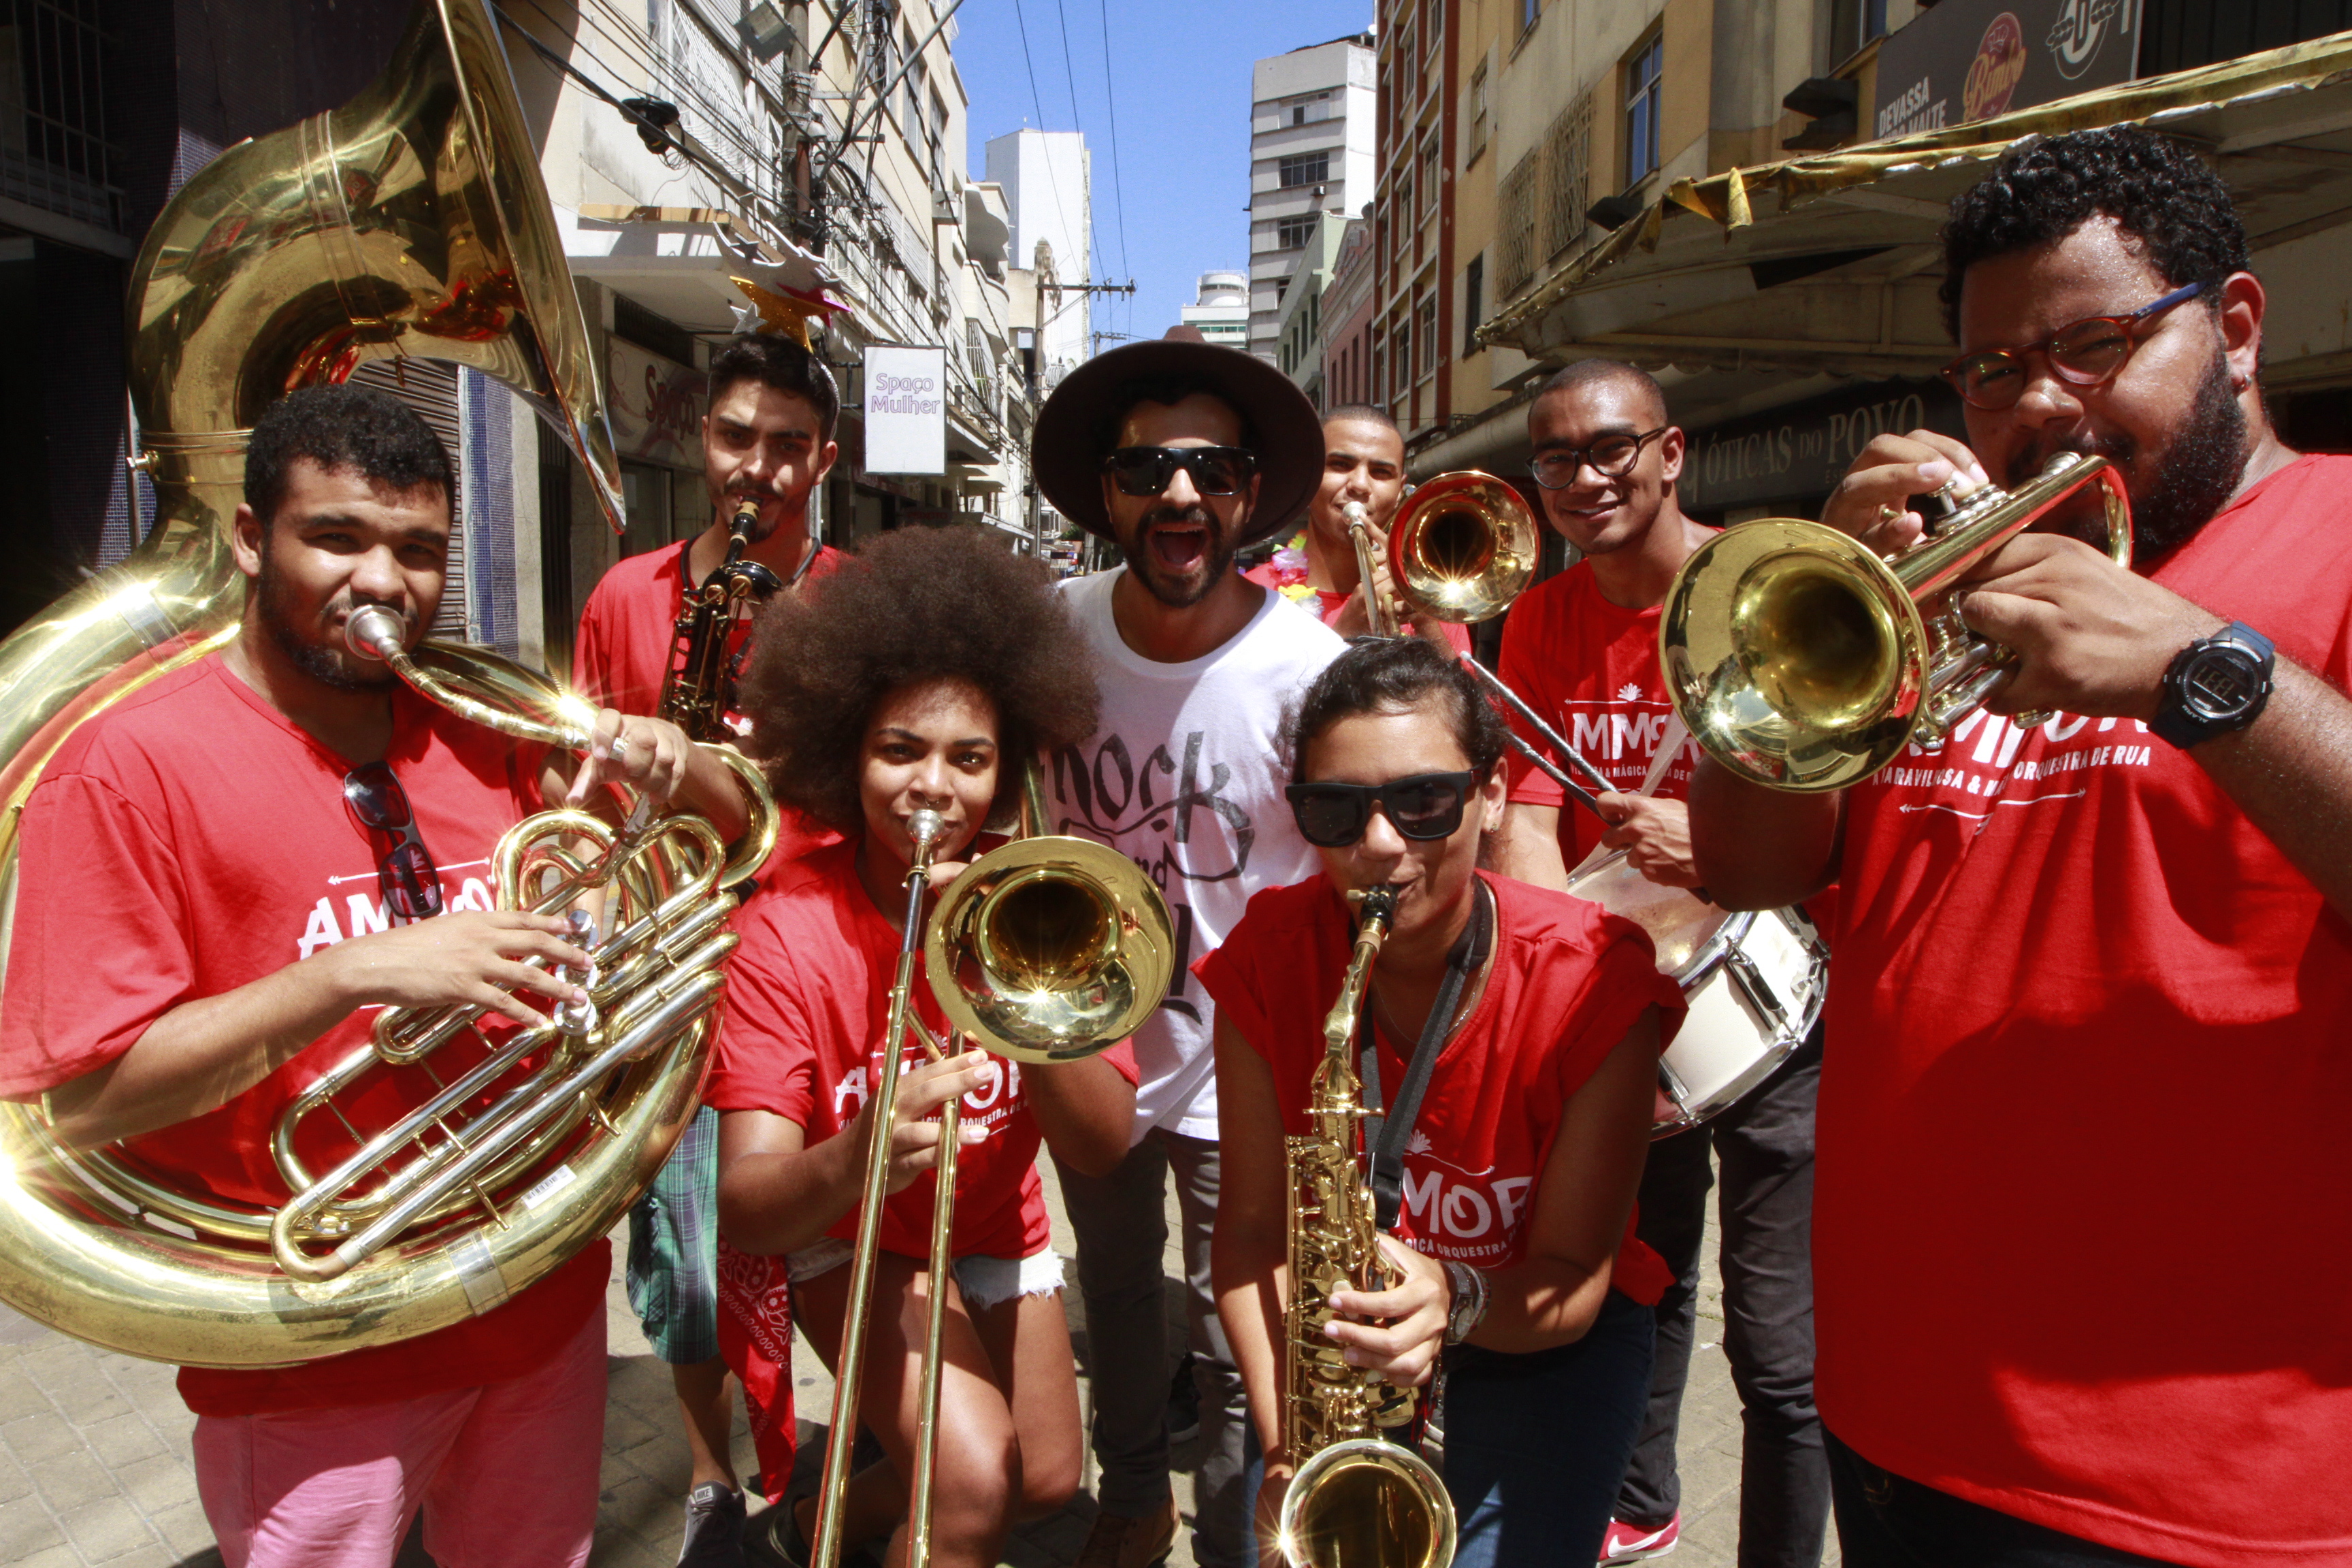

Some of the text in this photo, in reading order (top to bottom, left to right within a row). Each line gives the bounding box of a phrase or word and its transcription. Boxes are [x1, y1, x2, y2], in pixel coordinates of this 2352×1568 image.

[1879, 76, 1929, 137] DEVASSA
[876, 373, 934, 394] Spaço
[871, 395, 940, 415] Mulher
[1707, 425, 1793, 485] ÓTICAS
[1800, 429, 1822, 459] DO
[1829, 395, 1925, 463] POVO
[2182, 704, 2208, 723] ALARM
[1613, 764, 1646, 777] MÁGICA
[2013, 745, 2151, 781] ORQUESTRA DE RUA
[1673, 770, 1684, 781] DE
[1967, 775, 1980, 794] &
[960, 1107, 1007, 1126] RQUESTRA
[1437, 1241, 1507, 1258] ORQUESTRA
